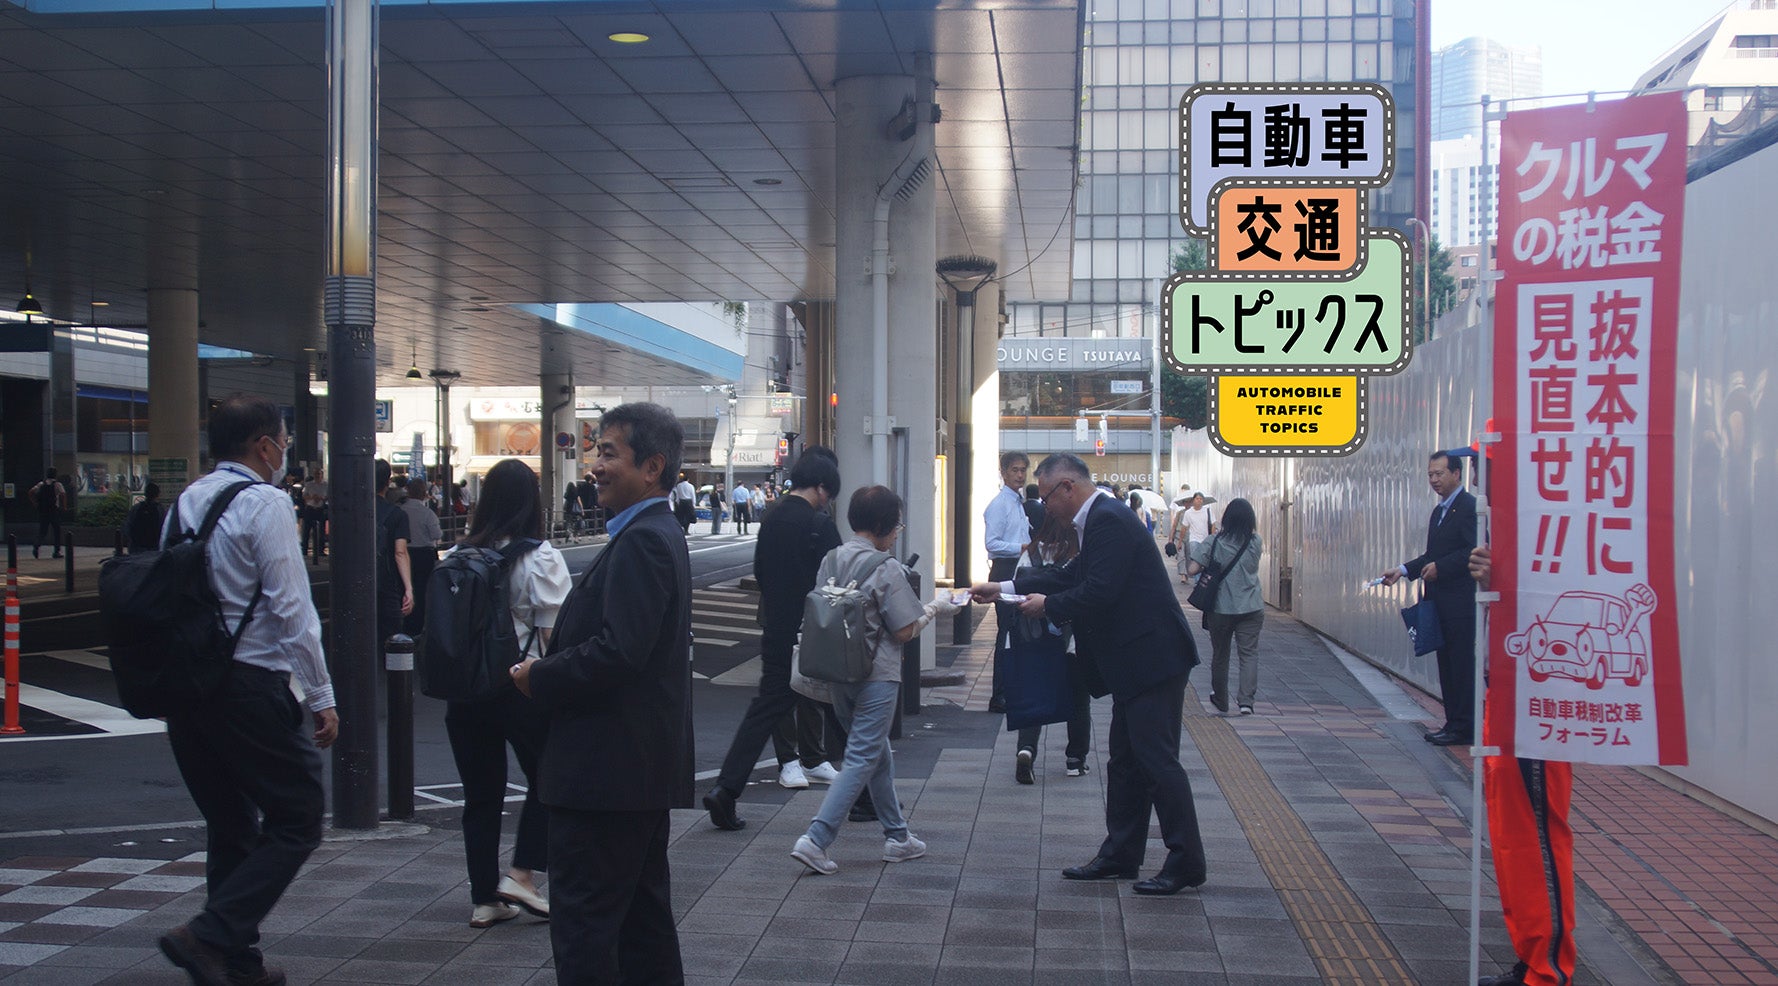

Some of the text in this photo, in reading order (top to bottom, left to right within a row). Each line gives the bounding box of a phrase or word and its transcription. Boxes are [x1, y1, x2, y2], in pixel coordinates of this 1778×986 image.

[1515, 132, 1669, 204] クルマ
[1513, 201, 1665, 270] の税金
[997, 347, 1142, 362] OUNGE TSUTAYA
[1585, 289, 1641, 576] 抜本的に
[1103, 473, 1152, 482] LOUNGE
[1529, 697, 1642, 723] 自動車税制改革
[1539, 723, 1631, 746] フォーラム
